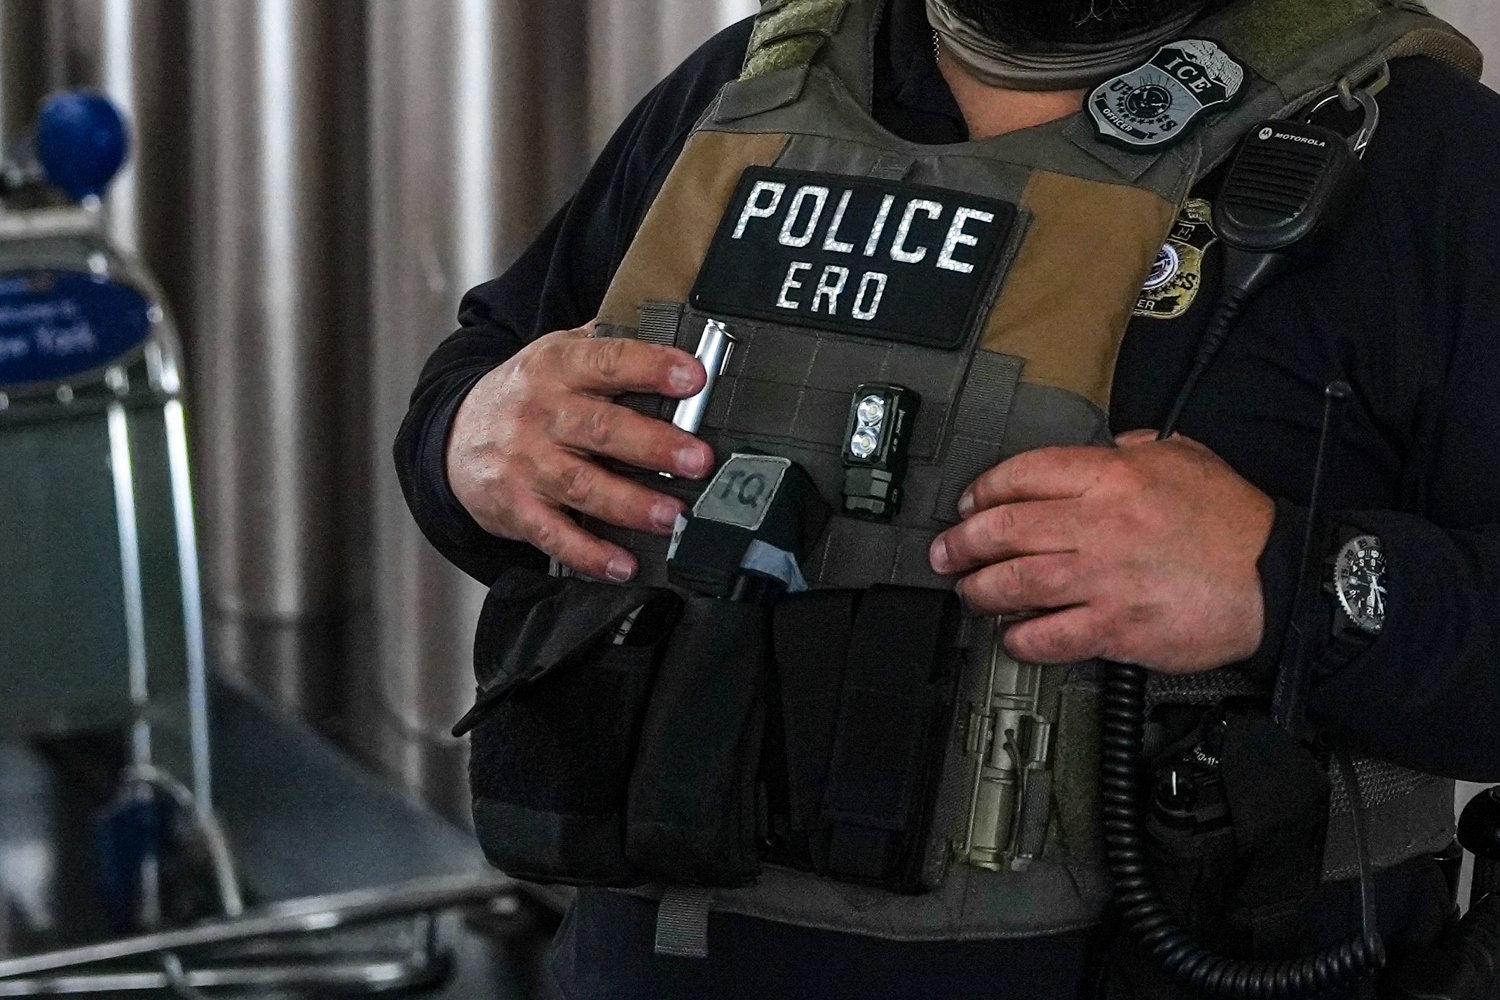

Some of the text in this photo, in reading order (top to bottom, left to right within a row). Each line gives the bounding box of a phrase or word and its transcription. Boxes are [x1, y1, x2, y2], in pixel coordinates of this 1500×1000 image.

[1163, 56, 1212, 93] ICE
[1102, 107, 1132, 133] OFFICER
[1274, 132, 1326, 147] MOTOROLA
[731, 180, 995, 274] POLICE
[776, 261, 888, 321] ERO
